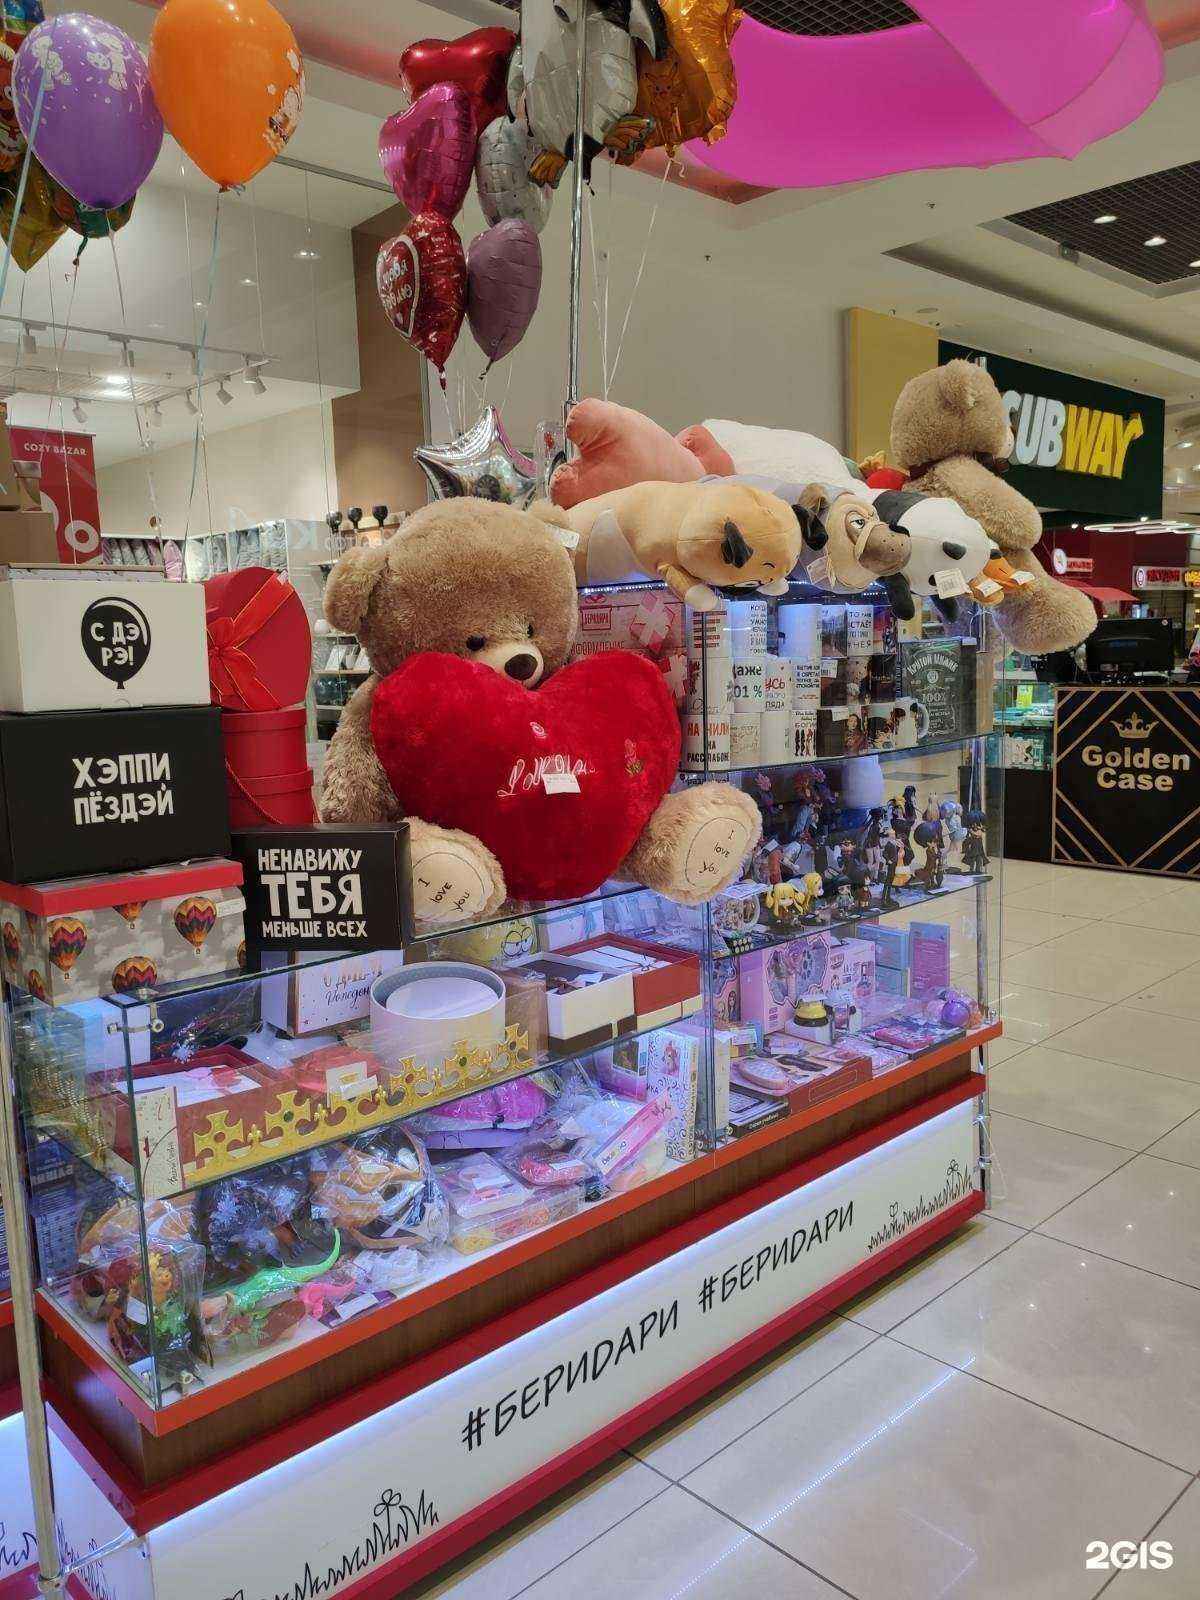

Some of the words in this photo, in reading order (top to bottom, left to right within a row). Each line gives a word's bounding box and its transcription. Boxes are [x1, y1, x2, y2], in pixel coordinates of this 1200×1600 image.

[24, 443, 50, 453] COZY
[53, 446, 87, 456] BAZAR
[90, 622, 106, 642] С
[112, 621, 140, 645] ДЭ
[101, 645, 134, 667] РЭ!
[1081, 744, 1191, 771] Golden
[71, 752, 171, 789] ХЭППИ
[1096, 766, 1174, 792] Case
[73, 782, 175, 826] ПЁЗДЭЙ
[257, 848, 363, 871] НЕНАВИЖУ
[260, 872, 364, 919] ТЕБЯ
[430, 881, 453, 904] love
[449, 891, 470, 912] you
[262, 920, 322, 938] МЕНЬШЕ
[326, 920, 368, 938] ВСЕХ
[461, 1299, 679, 1452] #БЕРИДАРИ
[698, 1200, 854, 1313] #БЕРИДАРИ
